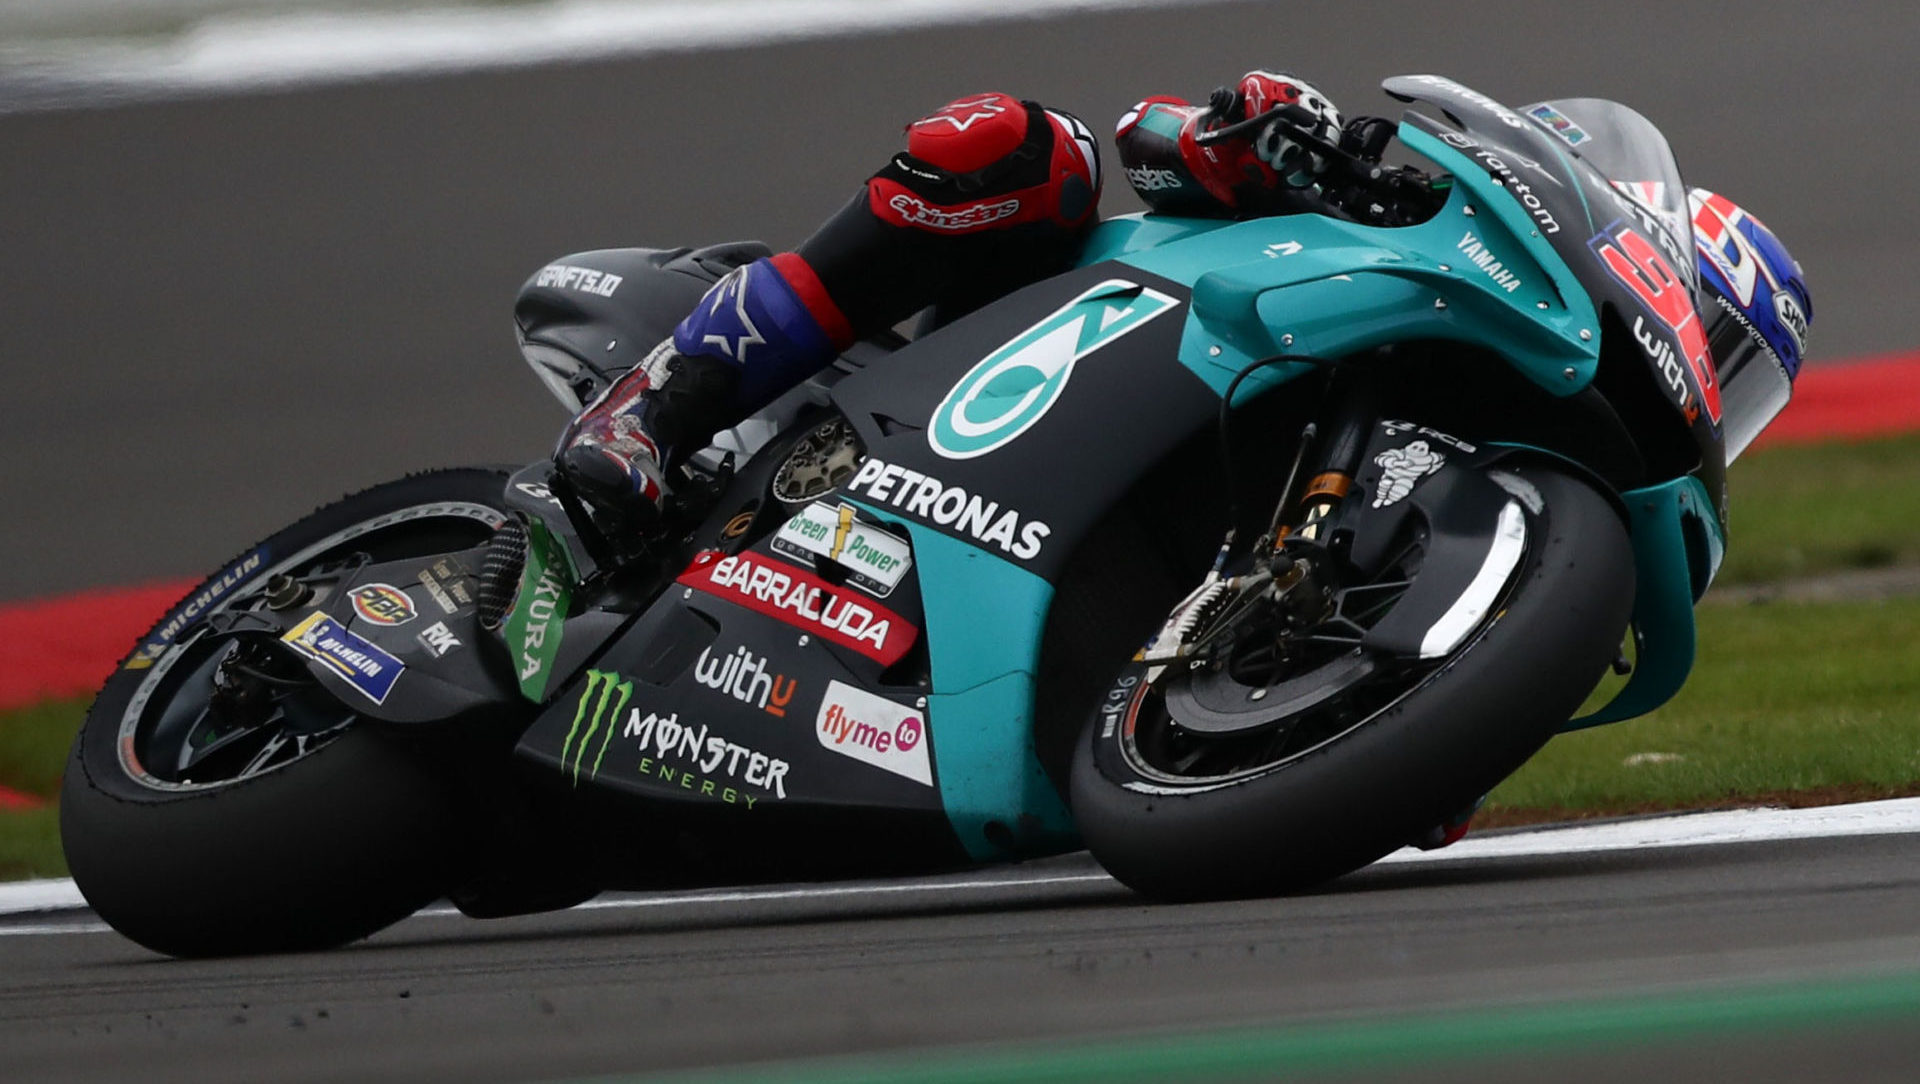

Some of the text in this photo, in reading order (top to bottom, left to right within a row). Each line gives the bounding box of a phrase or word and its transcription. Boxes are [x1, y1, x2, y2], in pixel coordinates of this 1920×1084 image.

[1457, 231, 1521, 293] YAMAHA
[847, 458, 1051, 560] PETRONAS
[788, 510, 901, 573] Green Power
[160, 553, 260, 641] MICHELIN
[709, 556, 890, 650] BARRACUDA
[421, 621, 462, 655] RK
[637, 757, 758, 811] ENERGY
